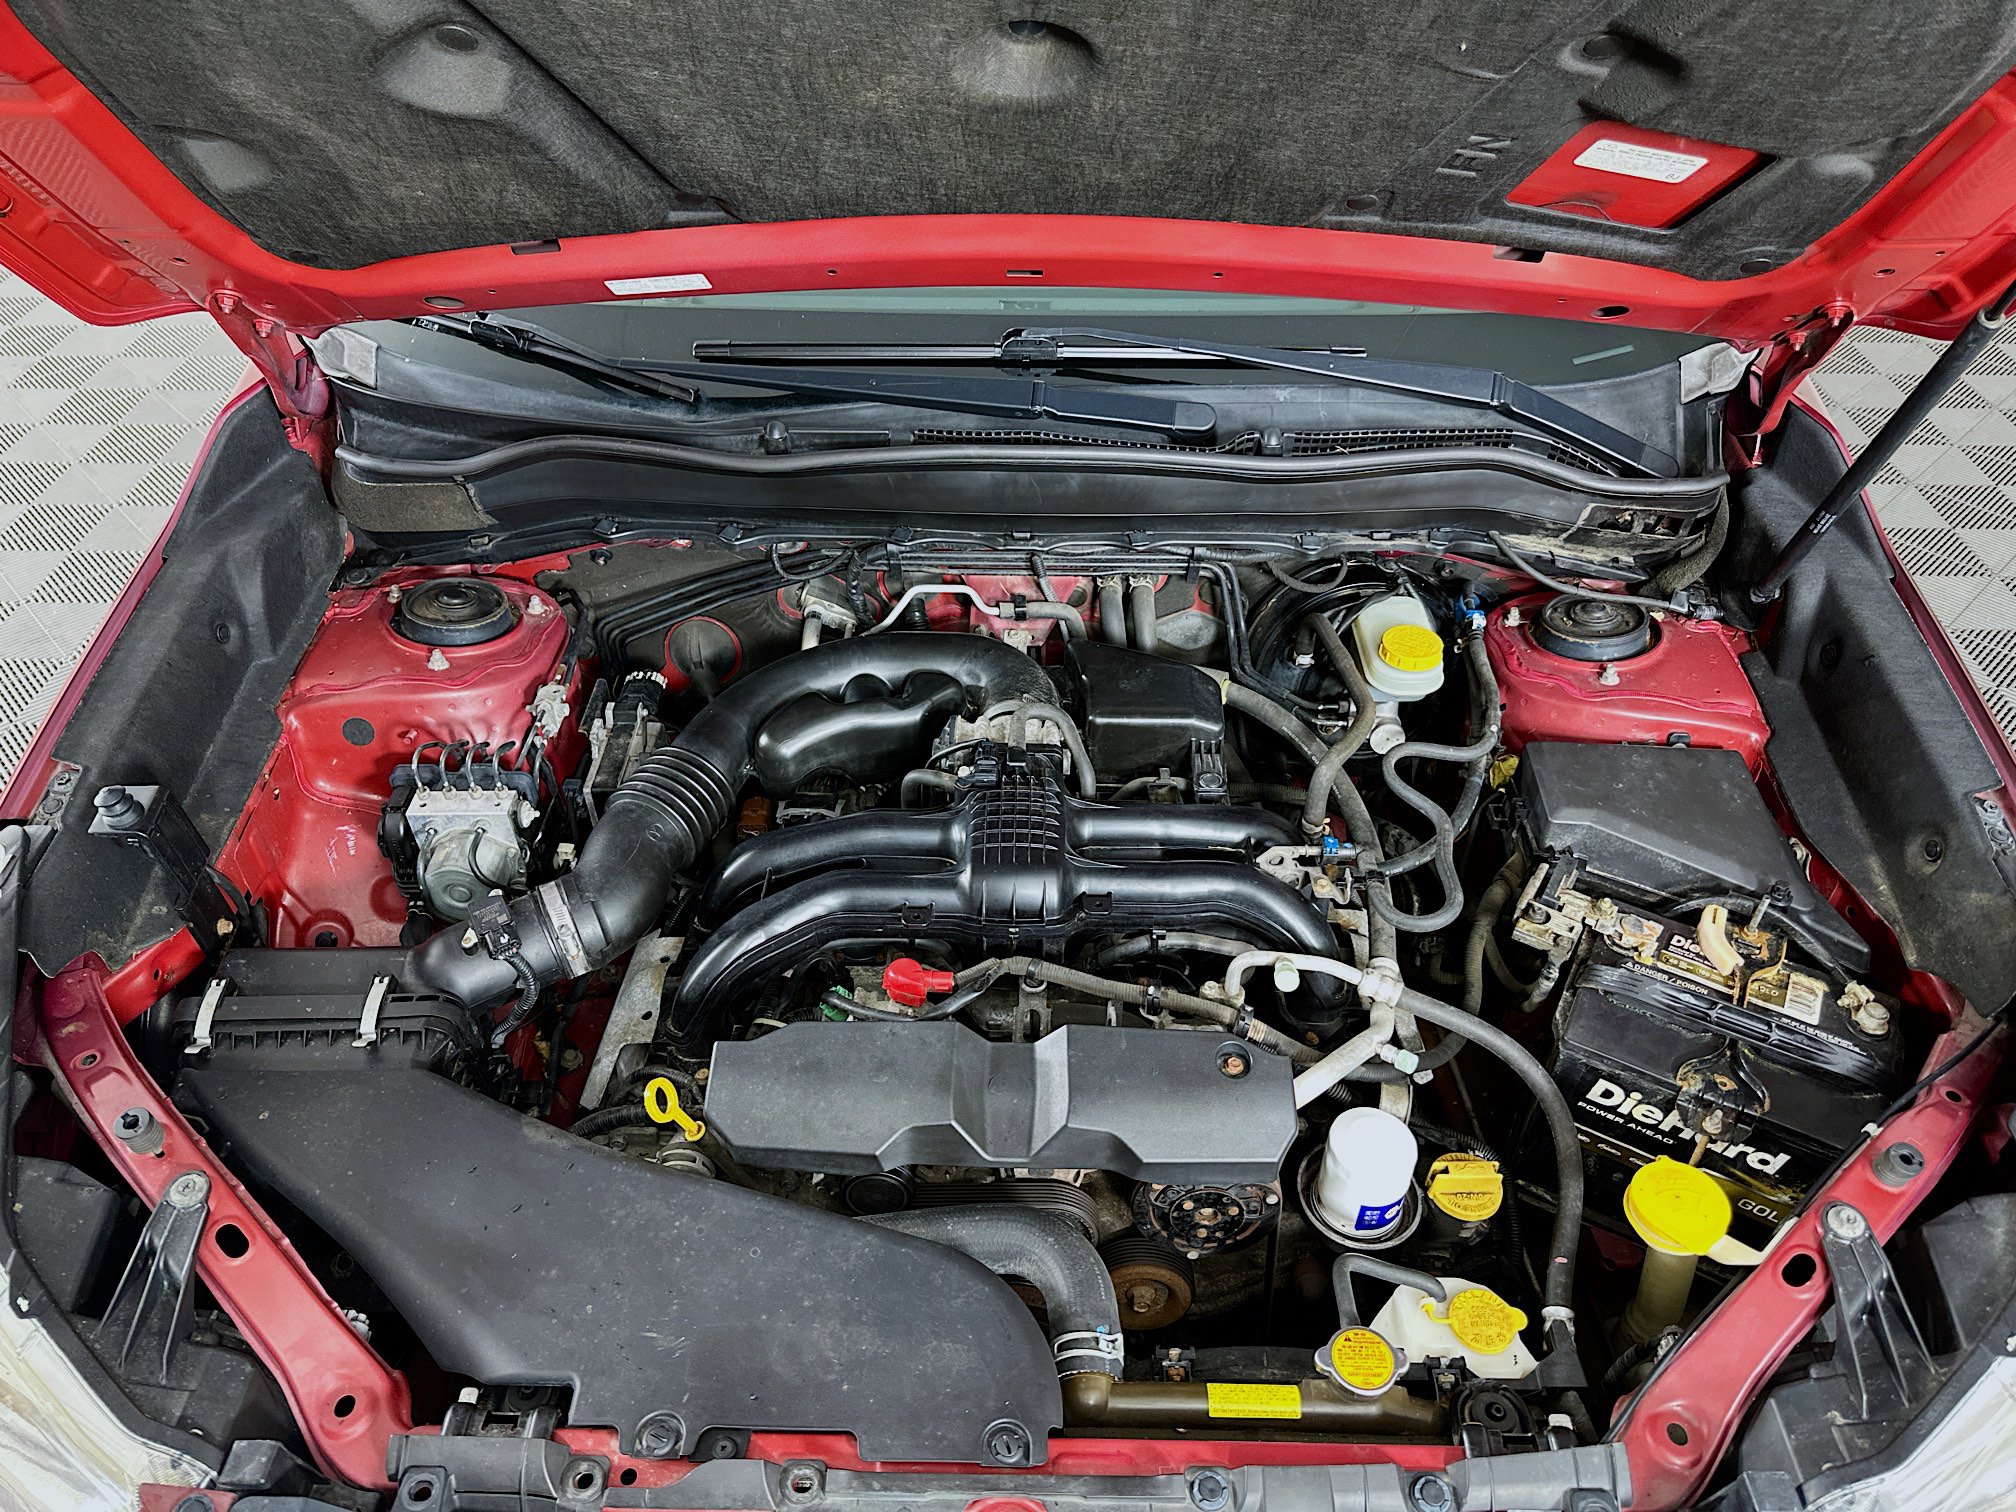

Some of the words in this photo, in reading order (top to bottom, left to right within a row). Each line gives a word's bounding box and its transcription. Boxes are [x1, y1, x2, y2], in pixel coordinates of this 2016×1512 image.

[1634, 964, 1669, 981] DANGER
[1676, 980, 1709, 995] POISON
[1577, 1101, 1625, 1124] POWER
[1627, 1123, 1674, 1145] AHEAD
[1737, 1198, 1779, 1223] GOL
